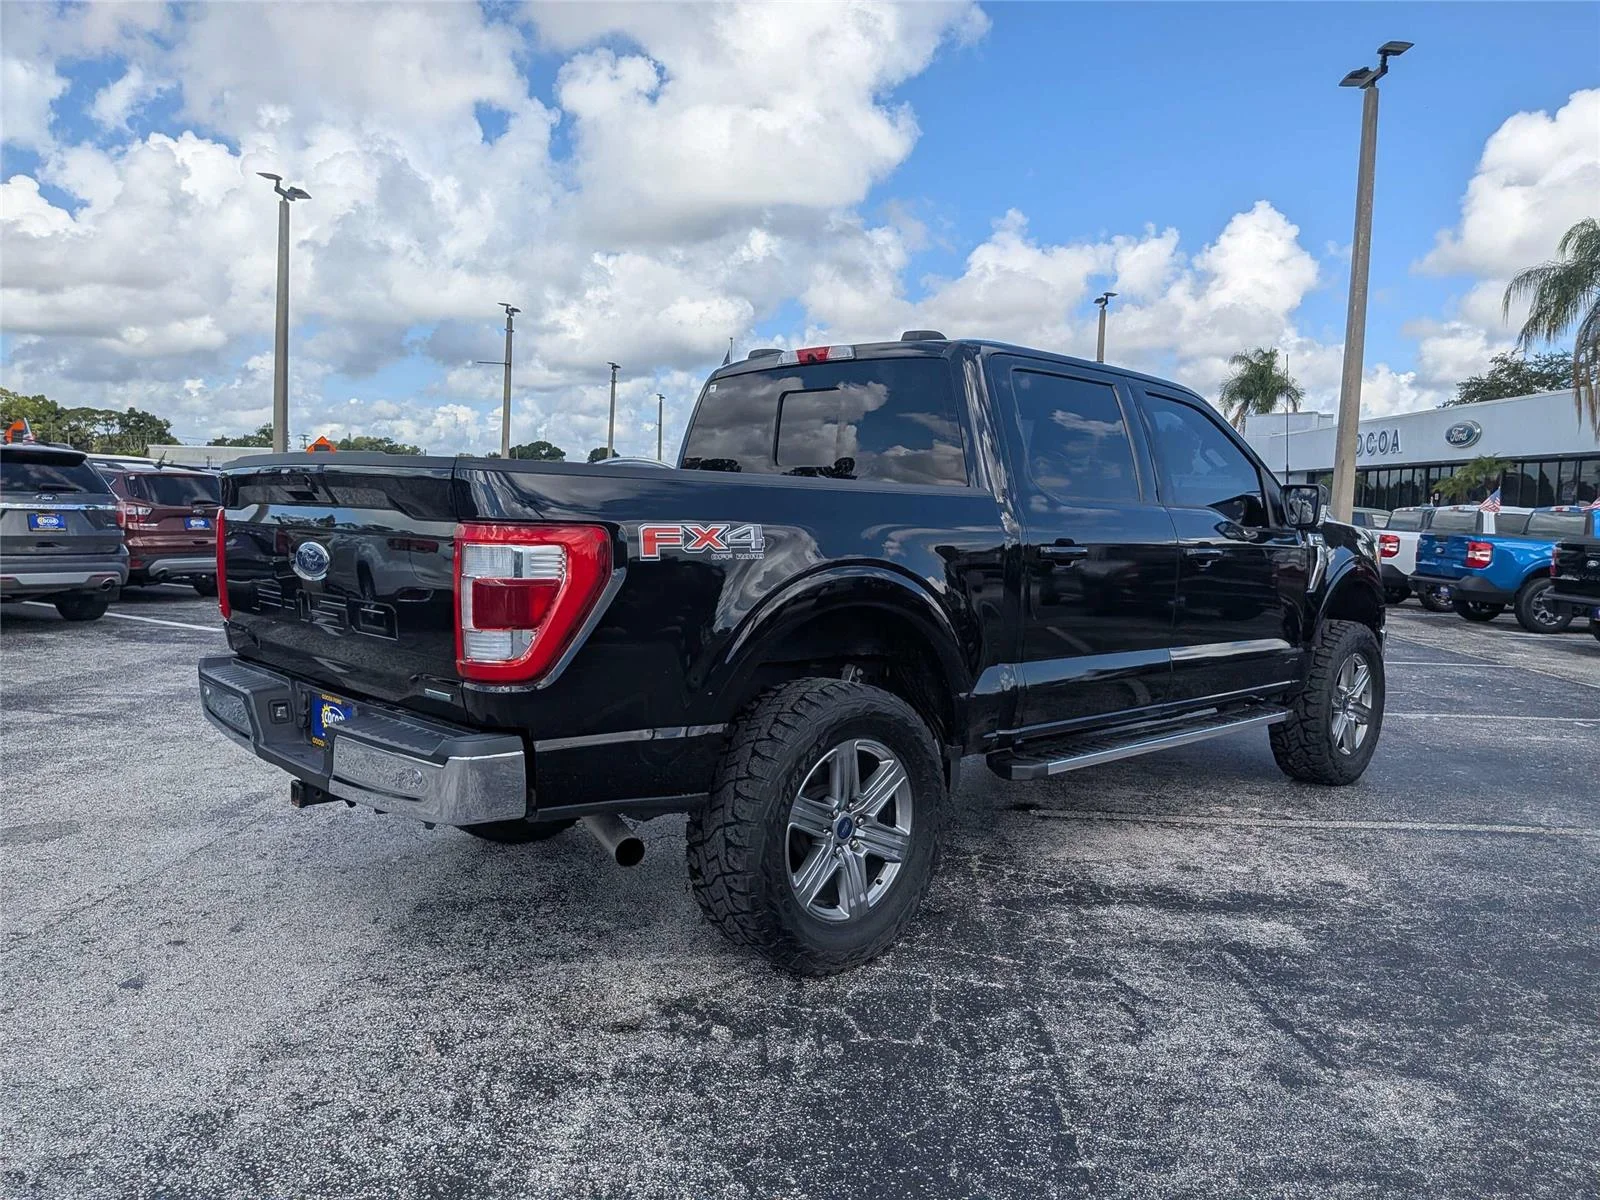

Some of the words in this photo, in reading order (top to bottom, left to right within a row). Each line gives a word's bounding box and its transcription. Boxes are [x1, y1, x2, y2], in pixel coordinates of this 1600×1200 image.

[1356, 429, 1401, 457] OCOA
[1450, 427, 1469, 442] Ford
[638, 523, 765, 561] FX4
